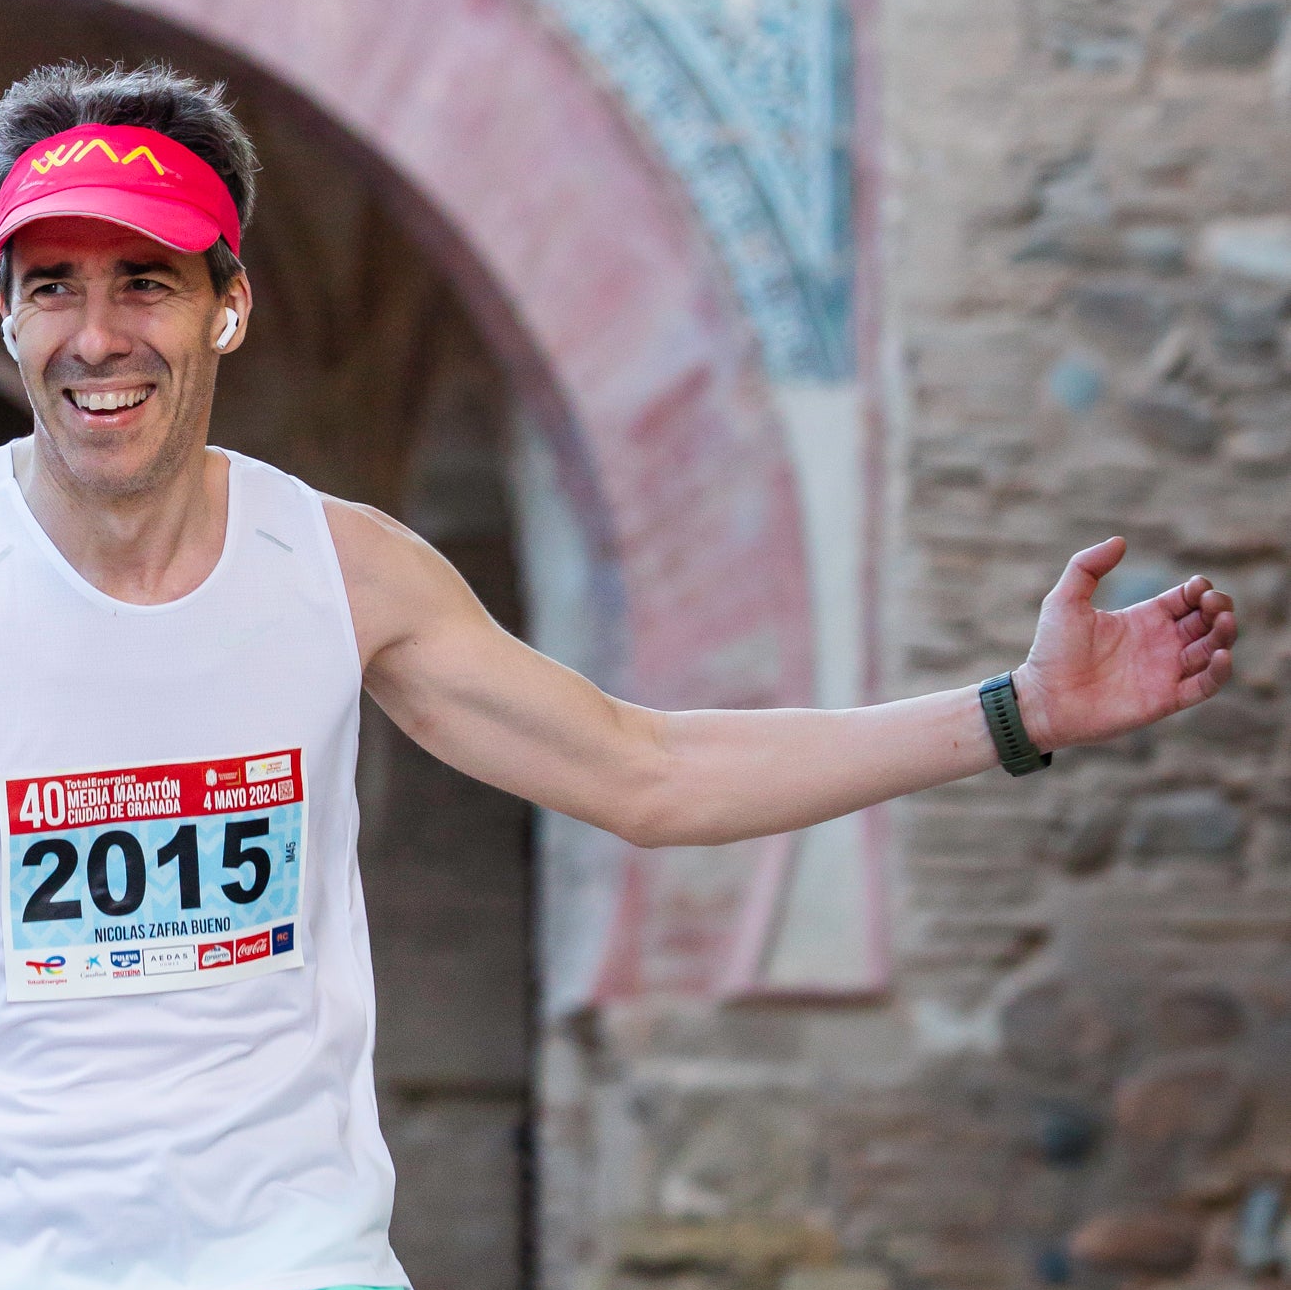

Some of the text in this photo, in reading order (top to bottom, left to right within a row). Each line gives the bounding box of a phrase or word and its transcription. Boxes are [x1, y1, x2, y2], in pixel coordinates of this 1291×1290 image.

[65, 773, 137, 791] TotalEnergies
[67, 776, 181, 809] MEDIA MARATÓN
[19, 780, 66, 828] 40
[203, 782, 277, 811] 4 MAYO 2024
[67, 797, 181, 825] CIUDAD DE GRANADA
[285, 841, 296, 863] M45
[22, 816, 271, 923] 2015
[94, 916, 231, 943] NICOLAS ZAFRA BUENO
[112, 953, 139, 963] PULEVA
[151, 953, 188, 962] AEDAS
